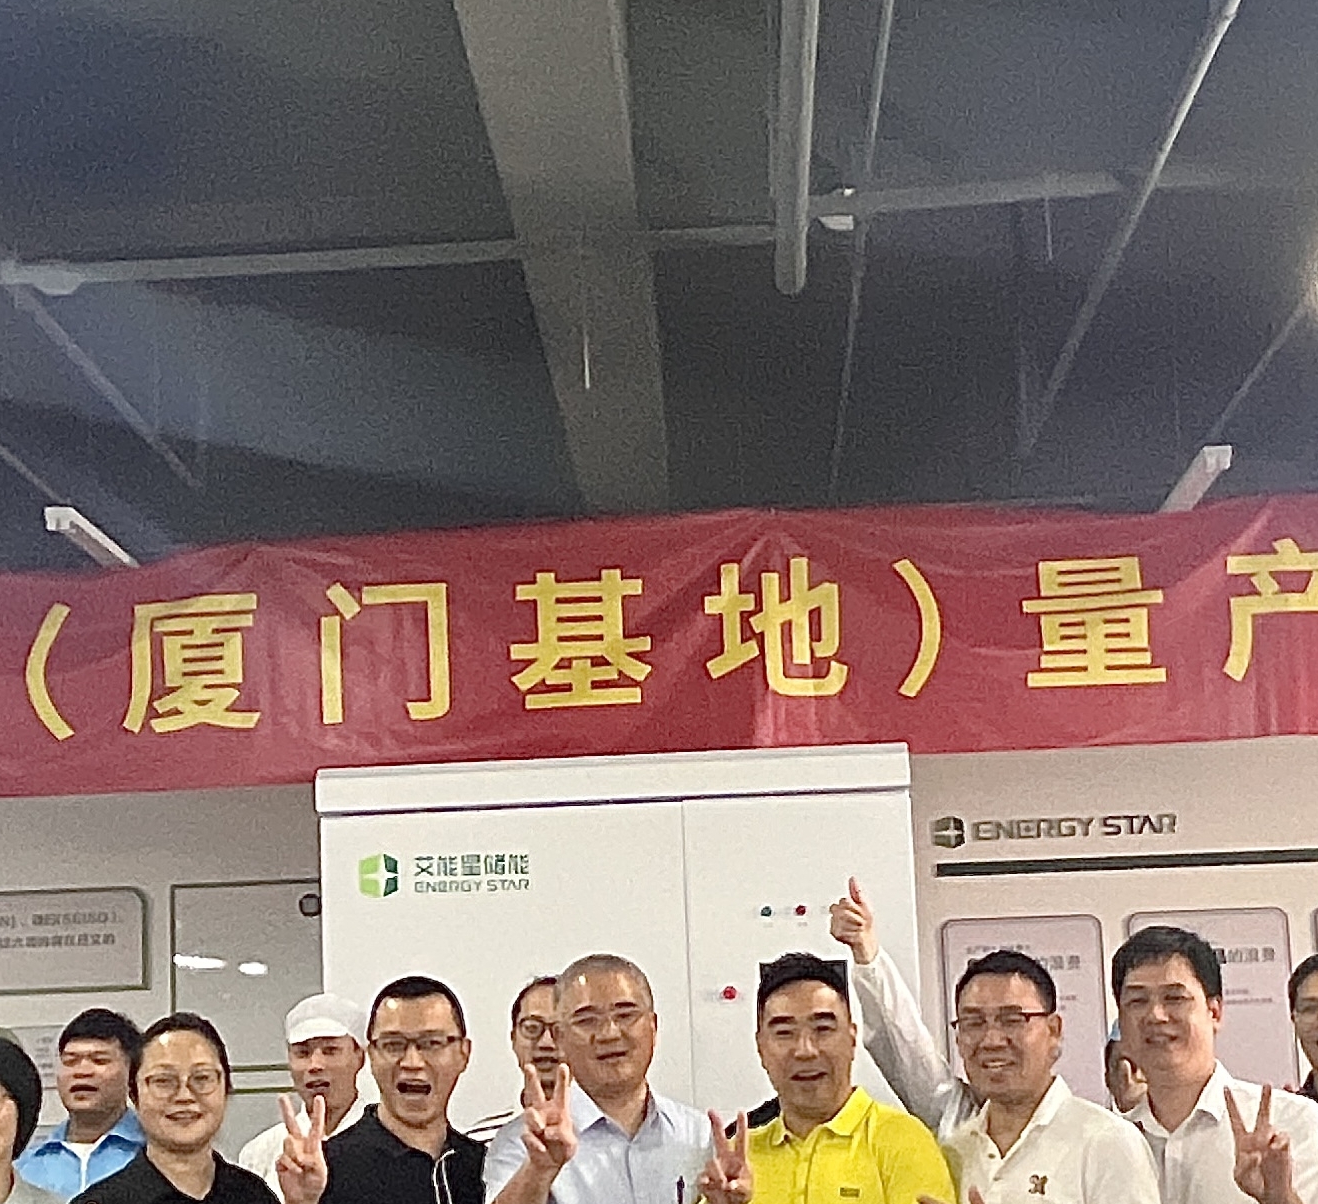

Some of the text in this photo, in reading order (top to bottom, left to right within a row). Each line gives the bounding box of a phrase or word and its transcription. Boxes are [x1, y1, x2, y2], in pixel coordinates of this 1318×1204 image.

[972, 813, 1177, 841] ENERGY STAR
[414, 853, 530, 877] 艾能星储能
[414, 878, 530, 893] ENERGY STAR
